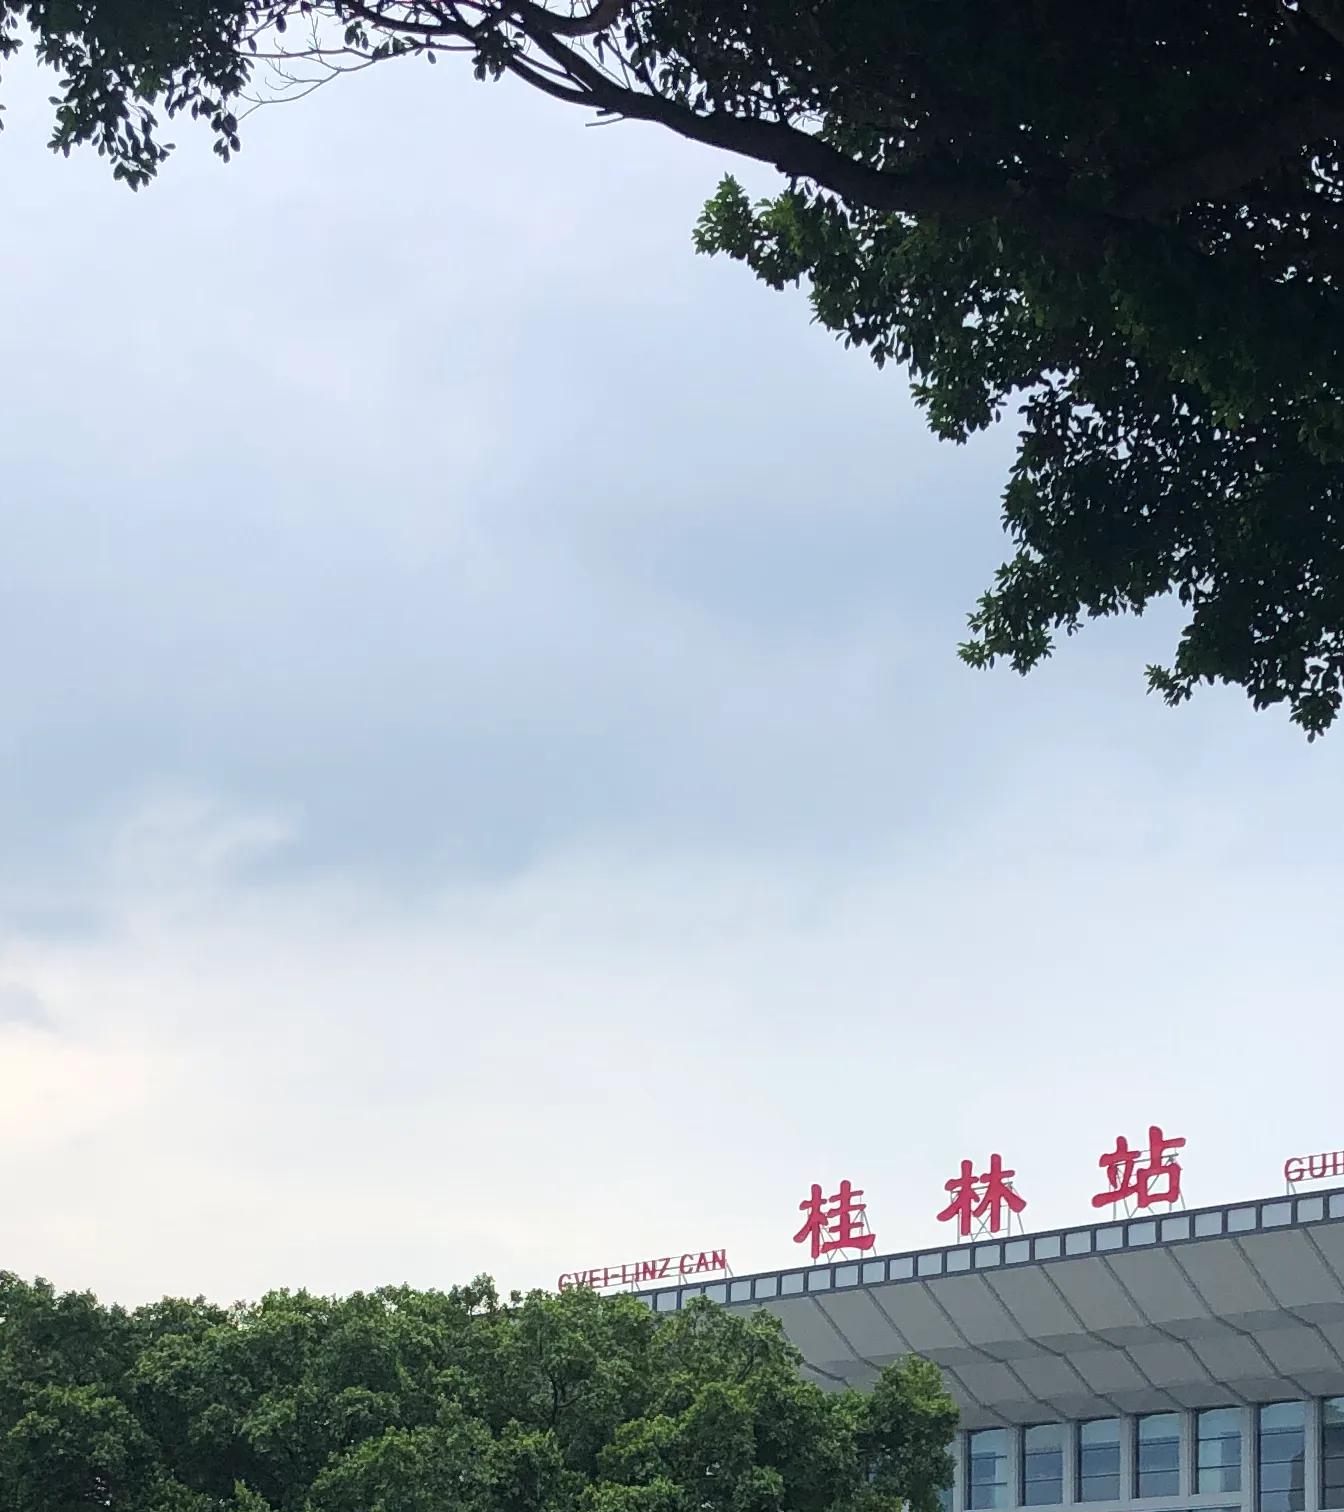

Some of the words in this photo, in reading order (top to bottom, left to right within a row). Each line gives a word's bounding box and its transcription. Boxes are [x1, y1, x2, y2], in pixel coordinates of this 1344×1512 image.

[793, 1125, 1186, 1259] 桂林站
[679, 1249, 726, 1275] CAN
